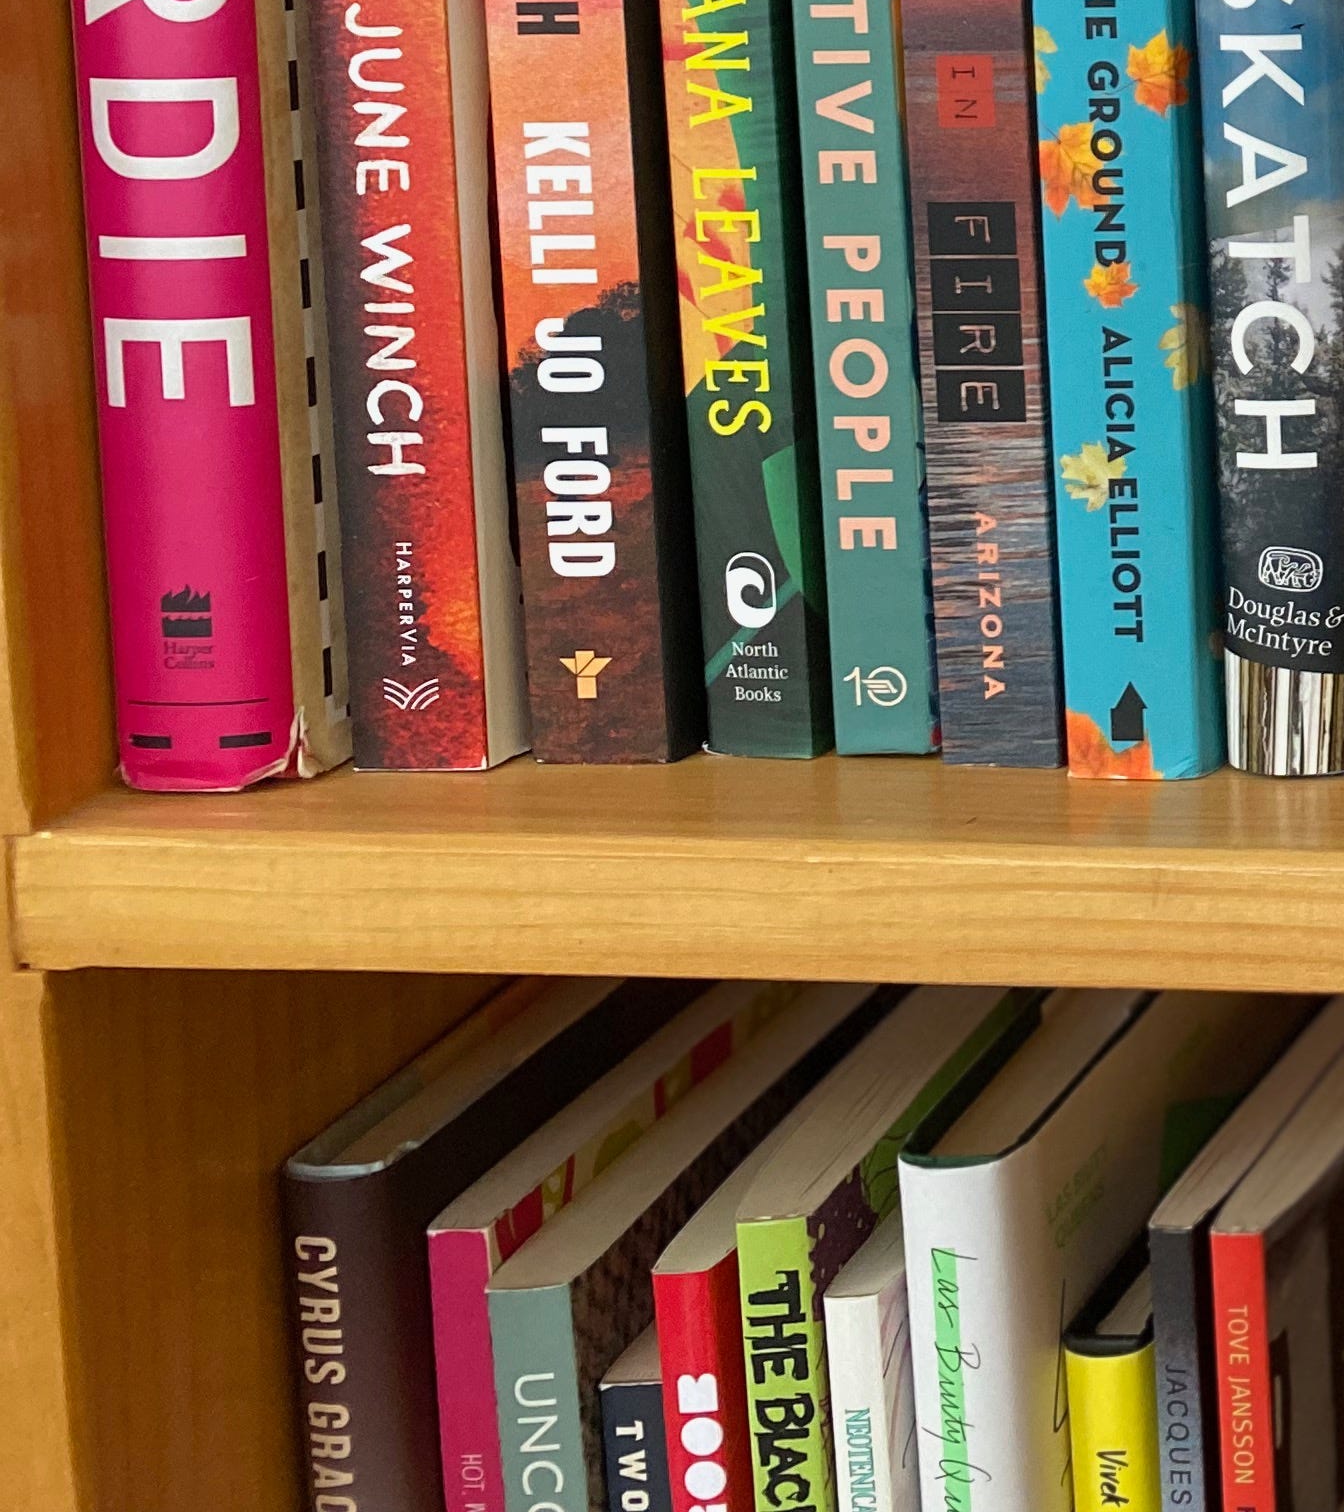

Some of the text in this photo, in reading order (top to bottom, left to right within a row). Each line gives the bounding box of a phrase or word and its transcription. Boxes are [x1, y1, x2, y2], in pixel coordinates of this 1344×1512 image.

[344, 4, 411, 195] JUNE
[950, 65, 979, 121] IN
[1085, 60, 1128, 265] GROUND
[360, 224, 426, 476] WINCH
[521, 122, 617, 579] KELLI JO FORD
[688, 166, 773, 437] LEAVES
[954, 215, 999, 412] FIRE
[822, 234, 897, 551] PEOPLE
[1101, 326, 1136, 463] ALICIA
[394, 541, 418, 667] HARPERVIA
[974, 511, 1006, 701] ARIZONA
[1107, 478, 1143, 643] ELLIOTT
[1228, 586, 1322, 629] Douglas
[163, 640, 214, 657] Harper
[163, 656, 215, 670] Collins
[726, 664, 788, 680] Atlantic
[731, 642, 778, 658] North
[734, 687, 781, 702] Books
[1226, 616, 1333, 657] McIntyre
[294, 1235, 347, 1385] CYRUS
[745, 1269, 810, 1385] THE
[931, 1247, 979, 1328] Las
[1165, 1364, 1193, 1506] JACQUES
[1226, 1304, 1256, 1486] TOVE JANSSON
[615, 1420, 649, 1512] TWO
[1096, 1448, 1130, 1508] Vivek
